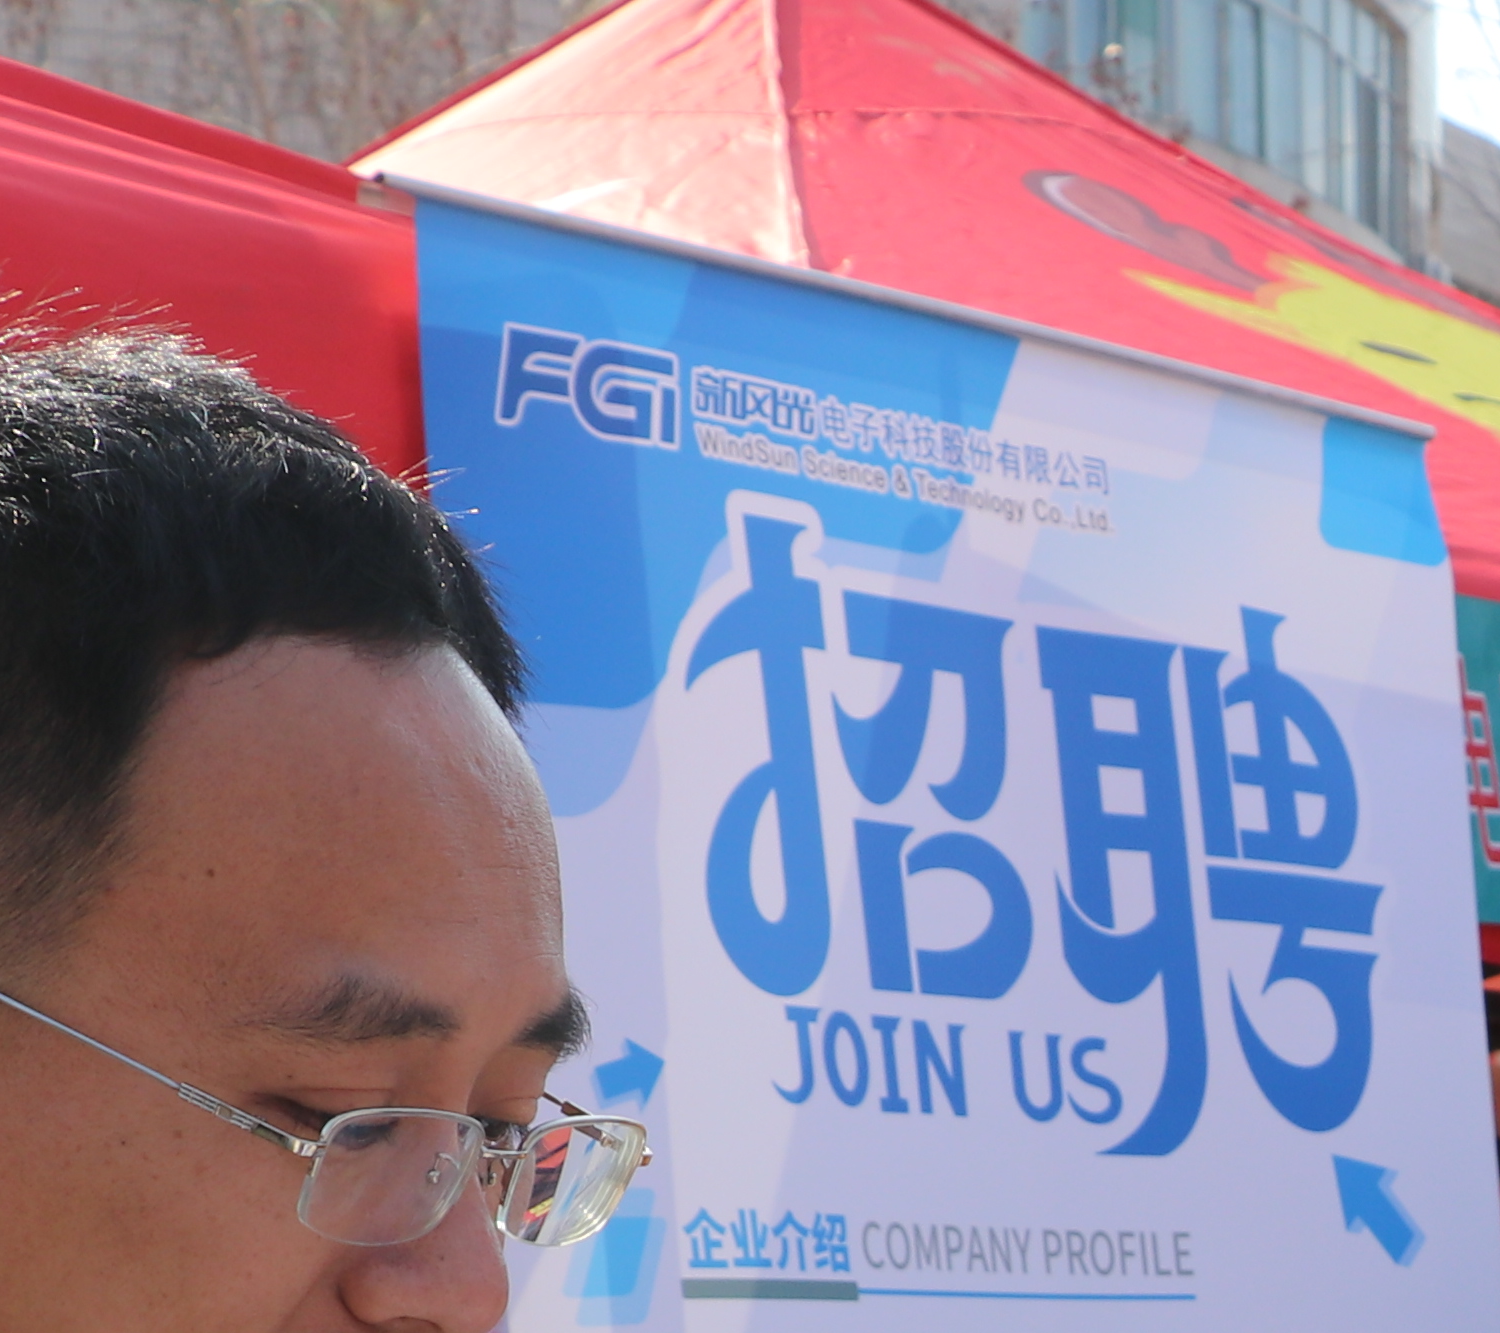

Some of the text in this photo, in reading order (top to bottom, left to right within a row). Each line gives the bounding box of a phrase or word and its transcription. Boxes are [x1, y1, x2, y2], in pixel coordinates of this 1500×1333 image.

[693, 366, 1110, 495] 新风光电子科技股份有限公司
[696, 425, 798, 474] WindSun
[804, 450, 886, 492] Science
[892, 464, 910, 497] &
[916, 470, 1027, 523] Technology
[684, 512, 1384, 1157] 招聘
[772, 1006, 1123, 1127] JOIN US
[684, 1208, 1196, 1279] 企业介绍 COMPANY PROFILE
